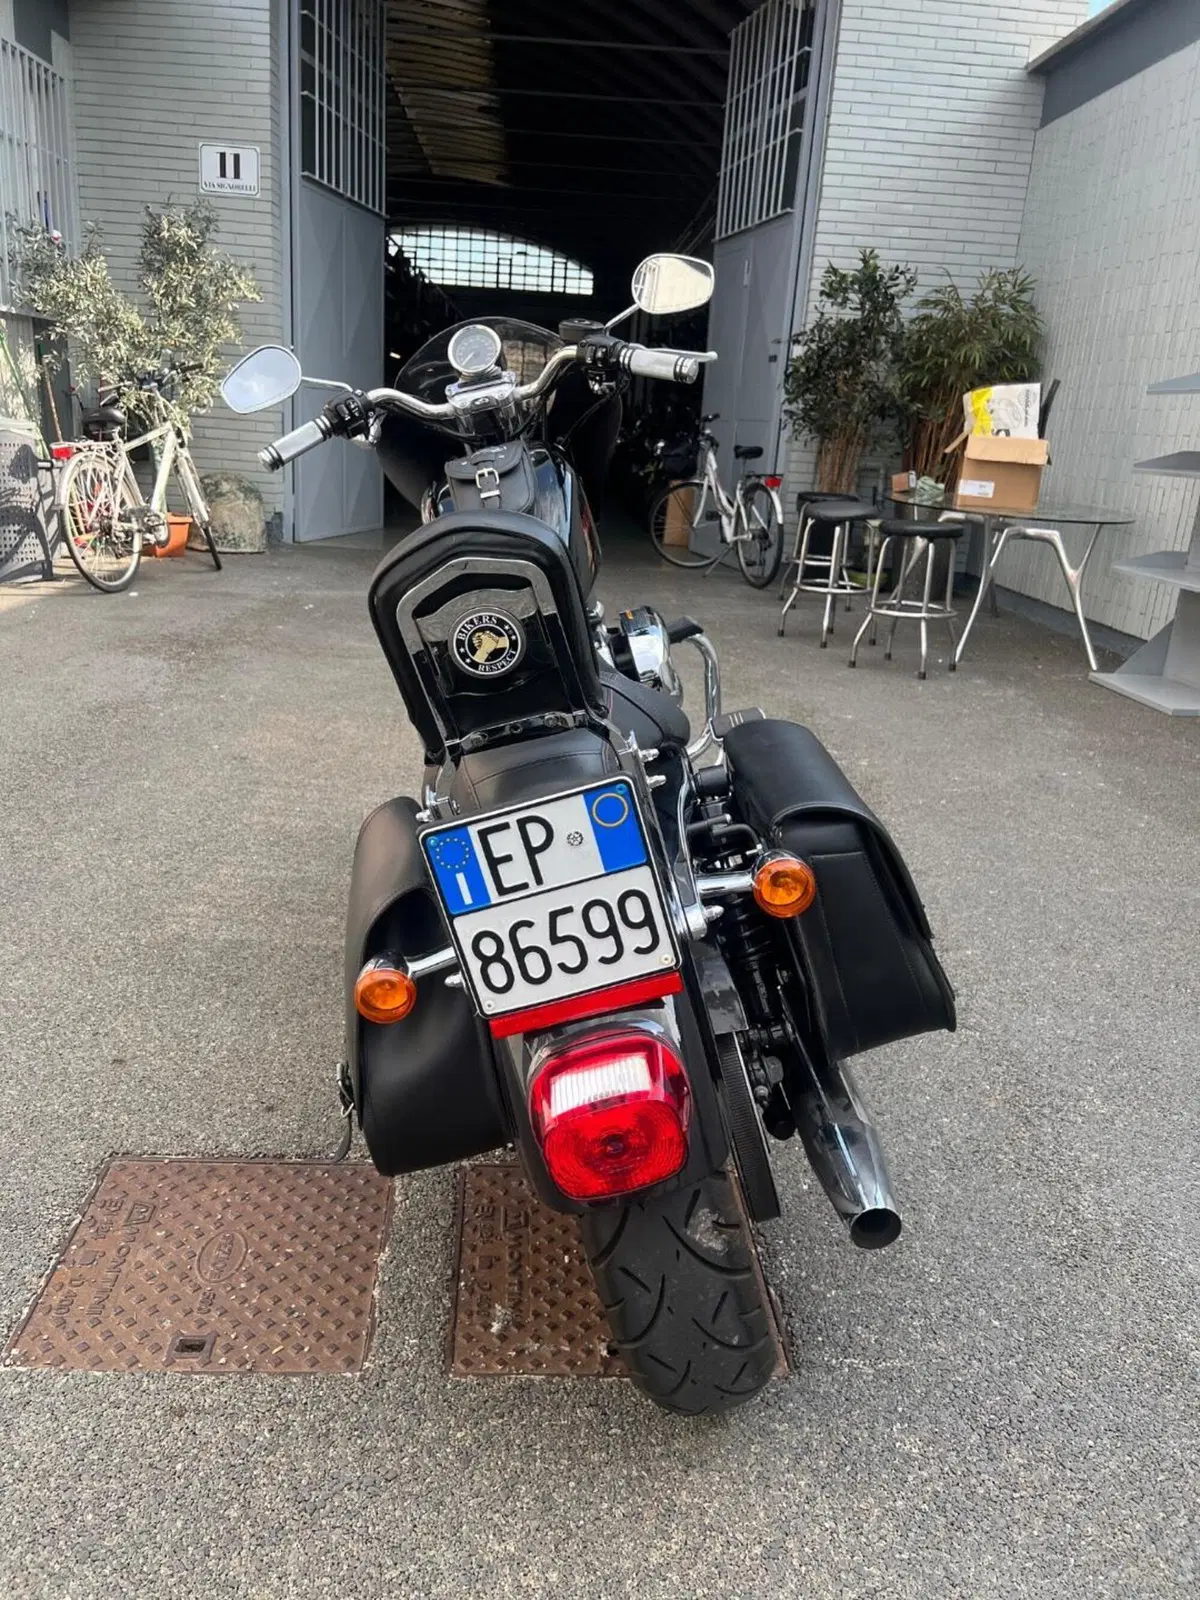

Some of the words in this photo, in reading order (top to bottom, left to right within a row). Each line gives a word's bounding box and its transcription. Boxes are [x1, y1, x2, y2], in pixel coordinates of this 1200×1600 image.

[214, 151, 243, 180] 11
[204, 181, 216, 189] VIA
[457, 615, 498, 641] BIKERS
[477, 648, 517, 672] RESPECT
[477, 815, 554, 896] EP
[471, 889, 660, 994] 86599
[86, 1226, 139, 1315] MONTINI
